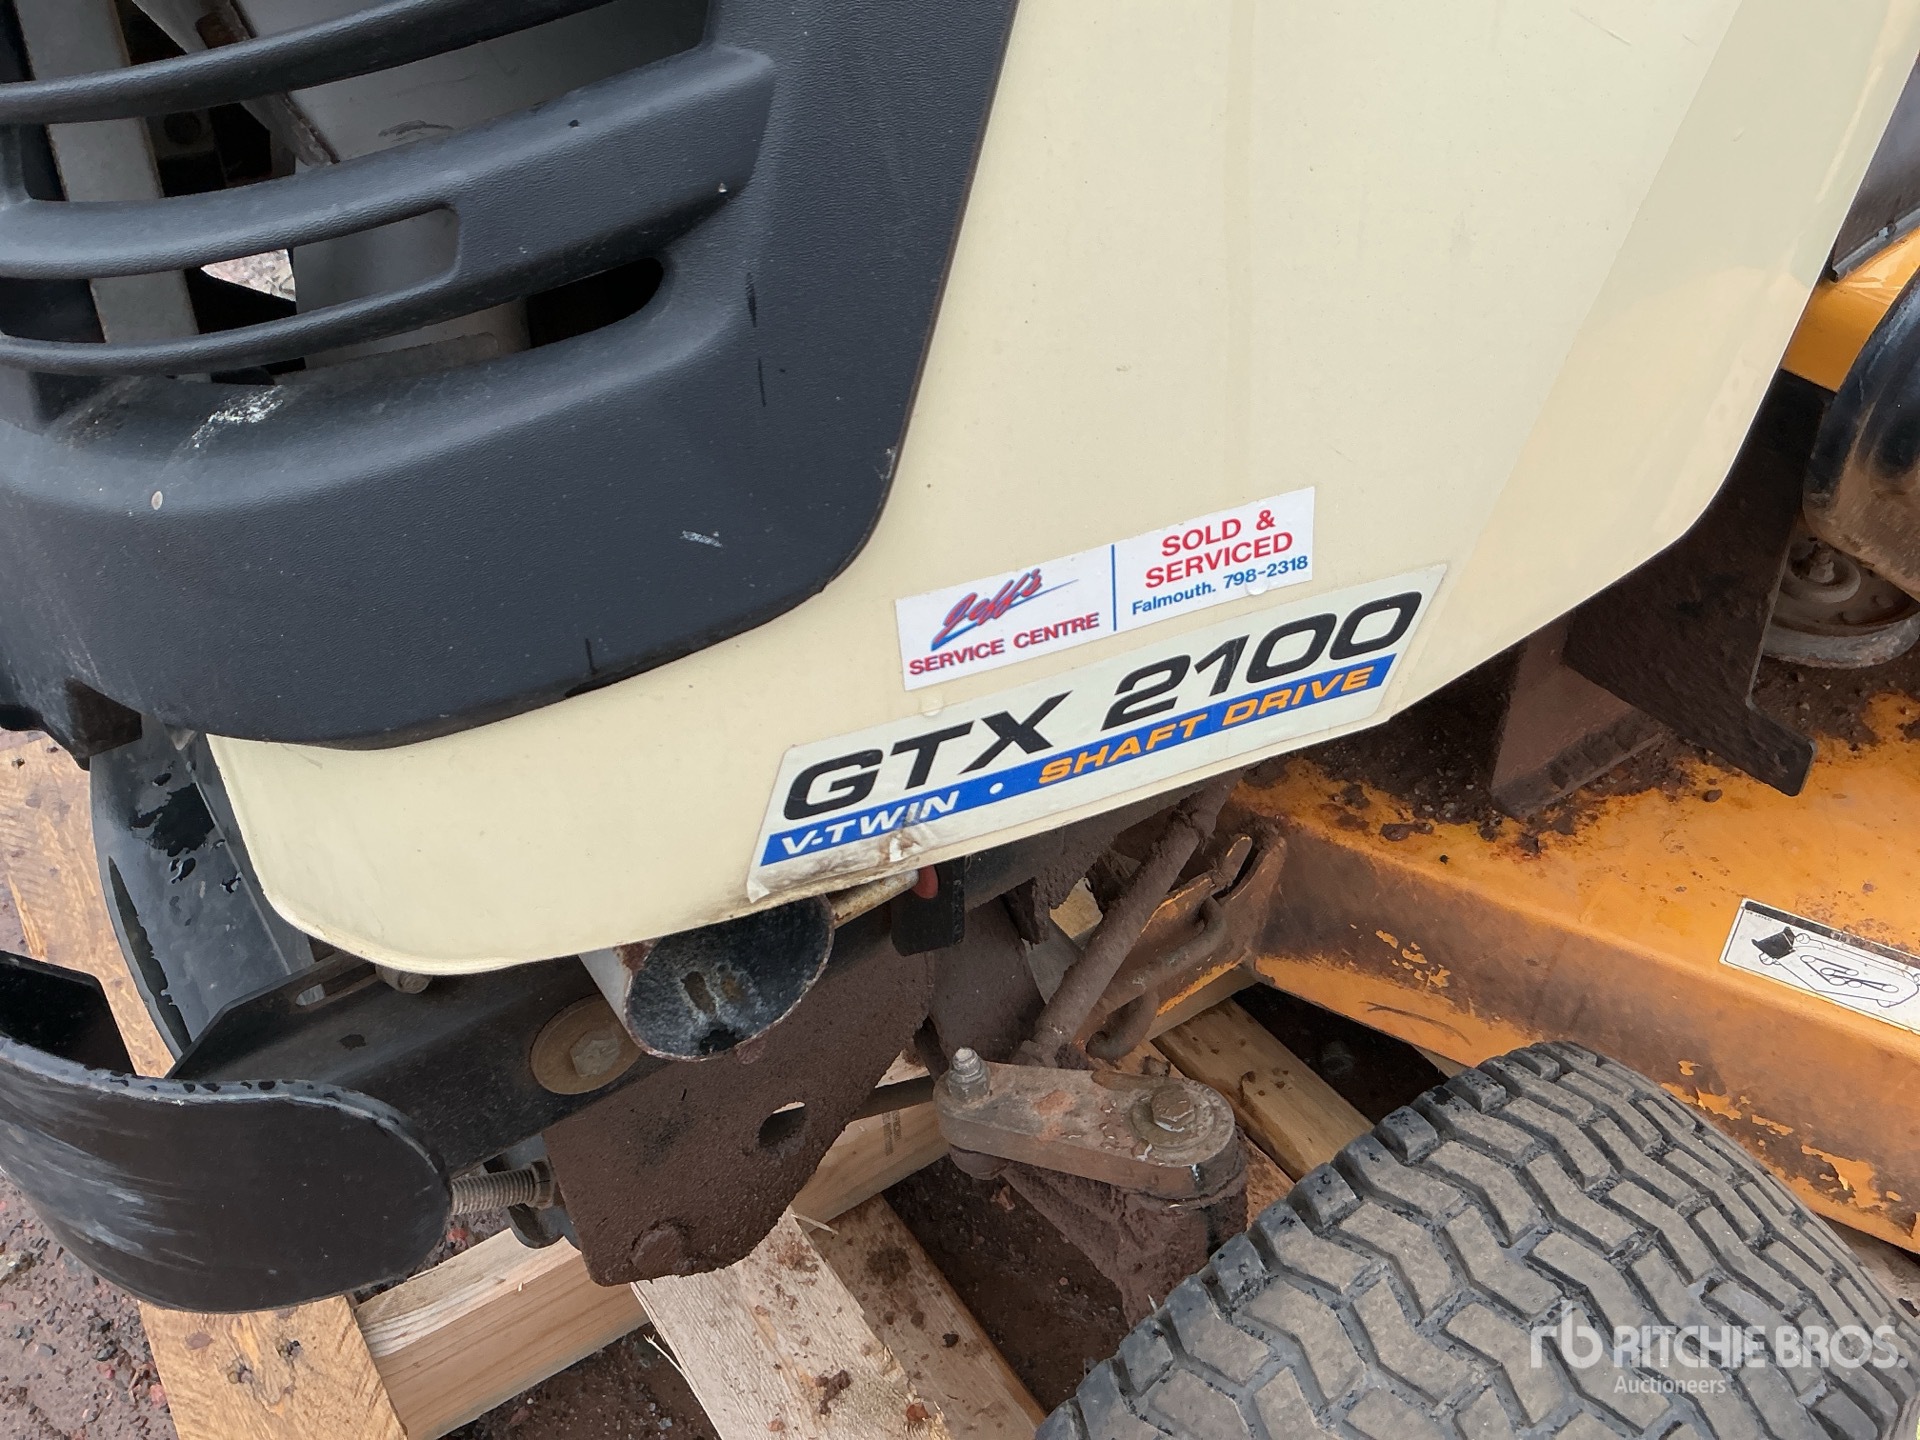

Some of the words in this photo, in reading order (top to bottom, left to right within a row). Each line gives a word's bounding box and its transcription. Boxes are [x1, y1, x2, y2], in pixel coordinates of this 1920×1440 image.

[1145, 531, 1293, 589] SERVICED
[1161, 518, 1241, 557] SOLD
[1256, 509, 1276, 531] &
[1131, 582, 1216, 616] Falmouth.
[1223, 555, 1308, 590] 798-2318
[909, 638, 1005, 677] SERVICE
[1013, 612, 1100, 650] CENTRE
[784, 690, 1074, 820] GTX
[1101, 591, 1422, 732] 2100
[781, 791, 960, 856] V-TWIN
[1038, 714, 1208, 784] SHAFT
[1221, 665, 1375, 727] DRIVE
